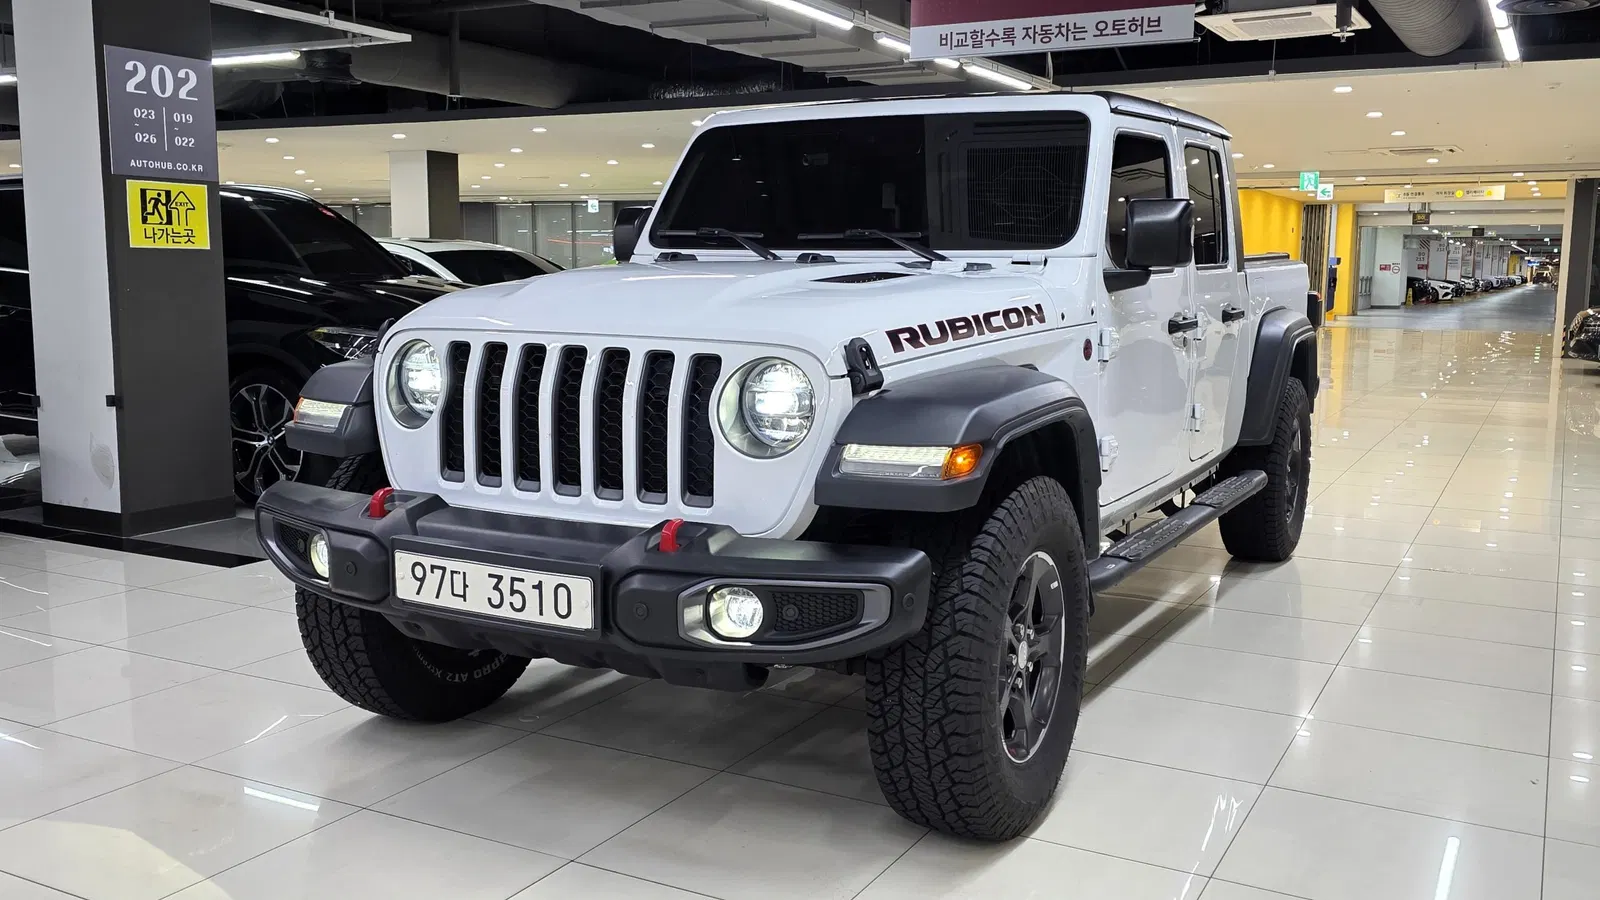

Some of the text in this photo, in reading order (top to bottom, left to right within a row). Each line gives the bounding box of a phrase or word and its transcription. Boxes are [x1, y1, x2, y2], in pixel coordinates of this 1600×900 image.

[939, 16, 1163, 50] 비교할수록 자동차는 오토허브
[124, 60, 198, 101] 202
[133, 107, 155, 120] 023
[173, 112, 193, 124] 019
[135, 132, 157, 144] 026
[174, 136, 195, 148] 022
[130, 159, 204, 172] AUTOHUB.CO.KR
[144, 227, 196, 244] 나가는곳
[885, 303, 1047, 353] RUBICON
[410, 561, 572, 620] 97다 3510
